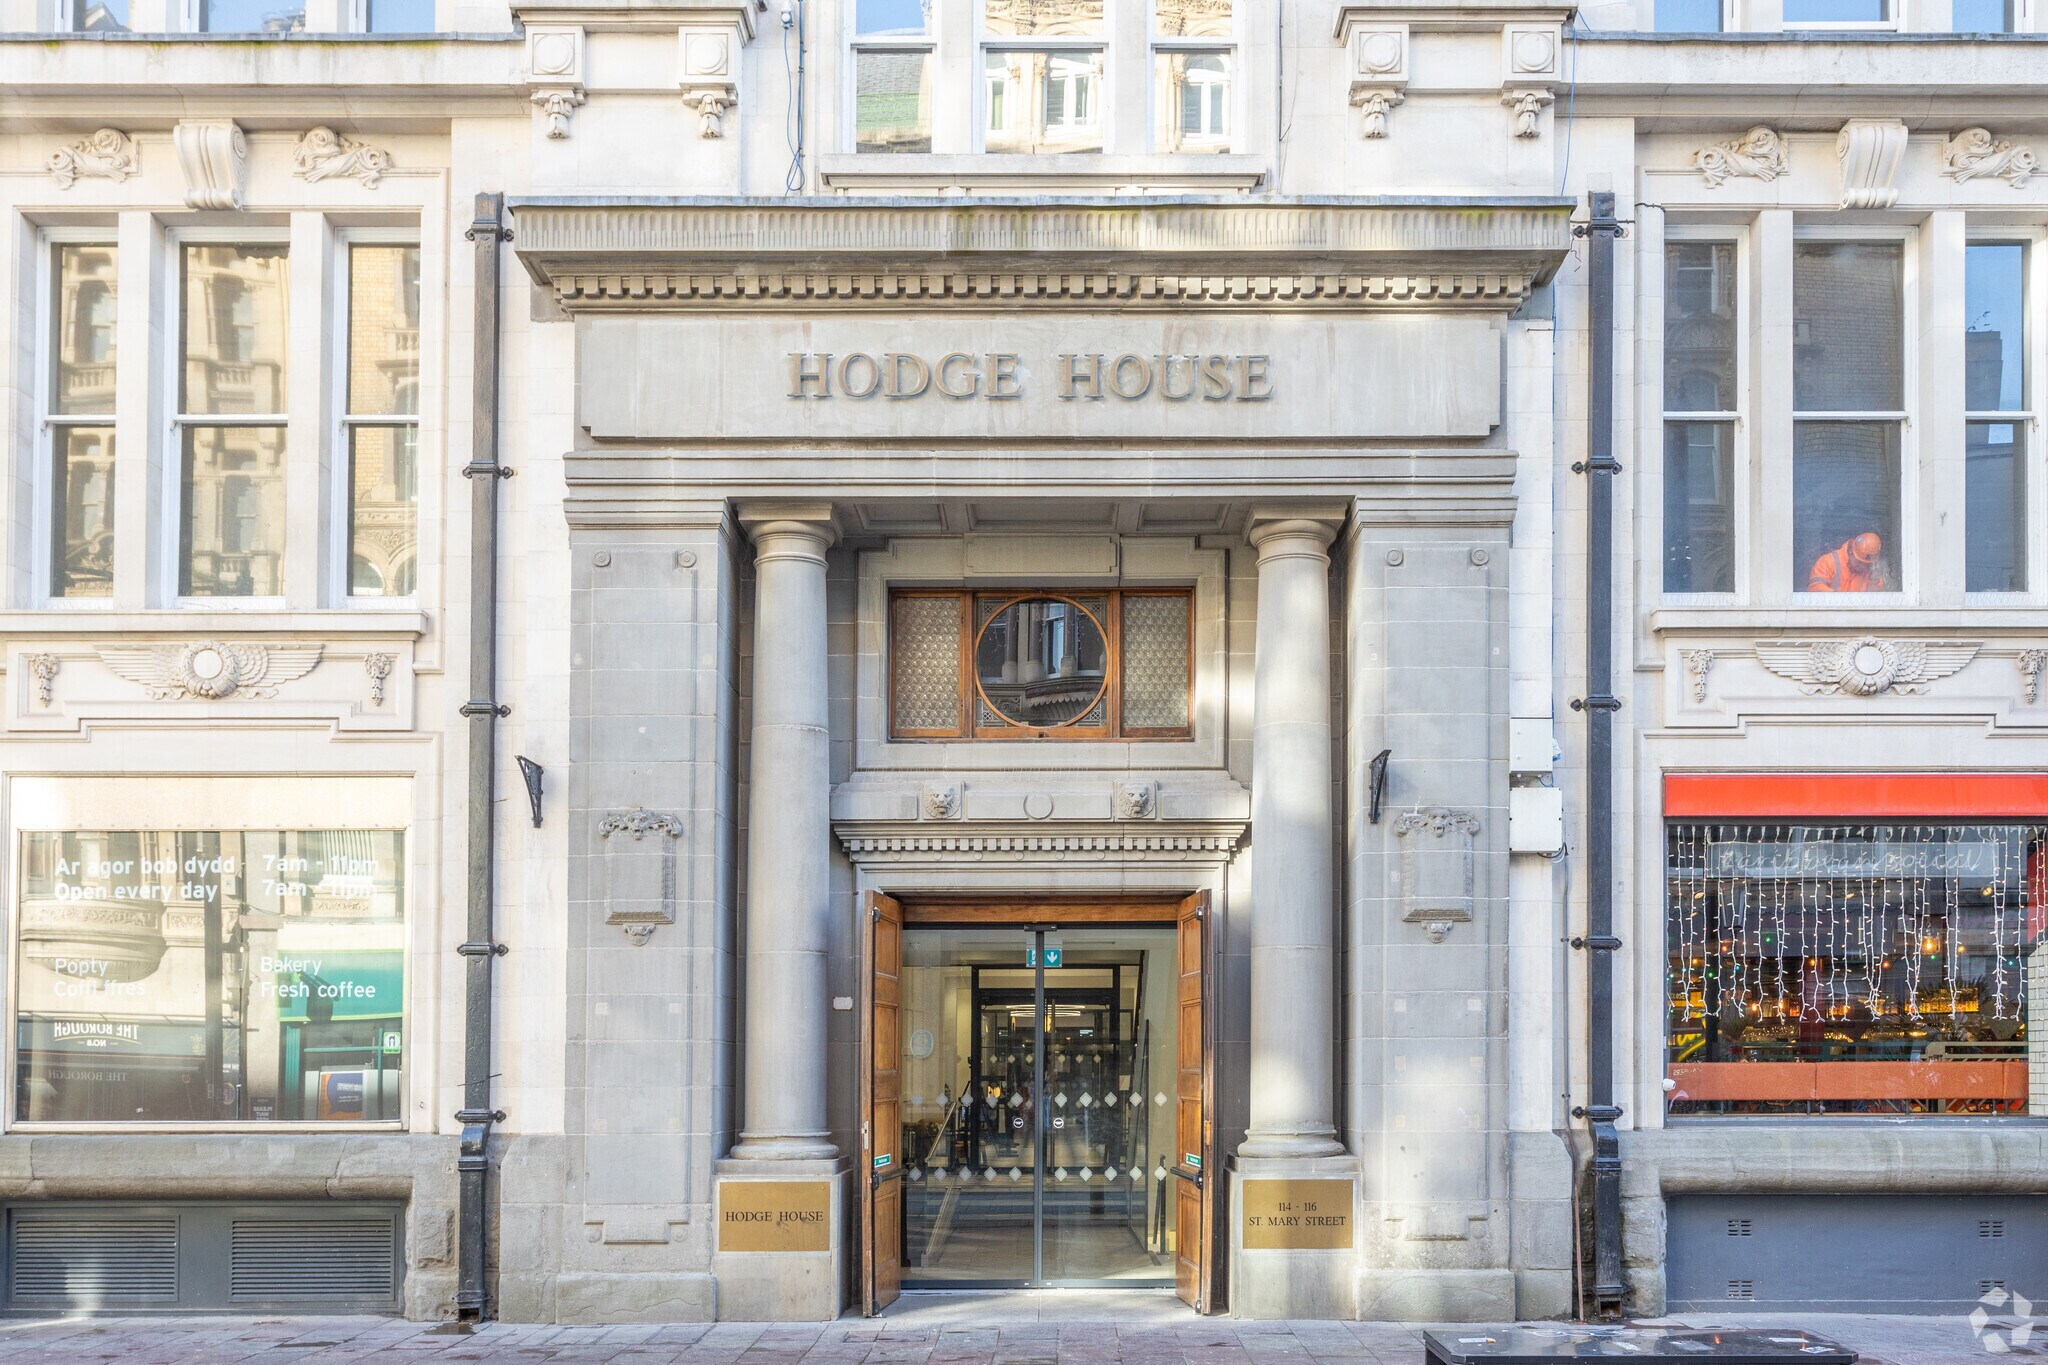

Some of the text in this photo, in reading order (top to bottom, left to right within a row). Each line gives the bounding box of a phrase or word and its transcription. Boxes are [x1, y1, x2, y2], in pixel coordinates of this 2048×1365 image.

[787, 352, 1275, 401] HODGE HOUSE
[55, 856, 235, 879] Ar agor bob dydd
[263, 854, 308, 872] 7am
[331, 855, 379, 877] 11pm
[54, 881, 218, 903] Open every day
[262, 879, 307, 897] 7am
[330, 880, 377, 900] 11pm
[54, 957, 108, 977] Popty
[260, 956, 322, 976] Bakery
[103, 979, 146, 996] ffres
[260, 981, 376, 998] Fresh coffee
[725, 1211, 824, 1222] HODGE HOUSE
[1278, 1202, 1291, 1212] 114
[1304, 1202, 1317, 1212] 116
[1248, 1216, 1347, 1226] ST. MARY STREET
